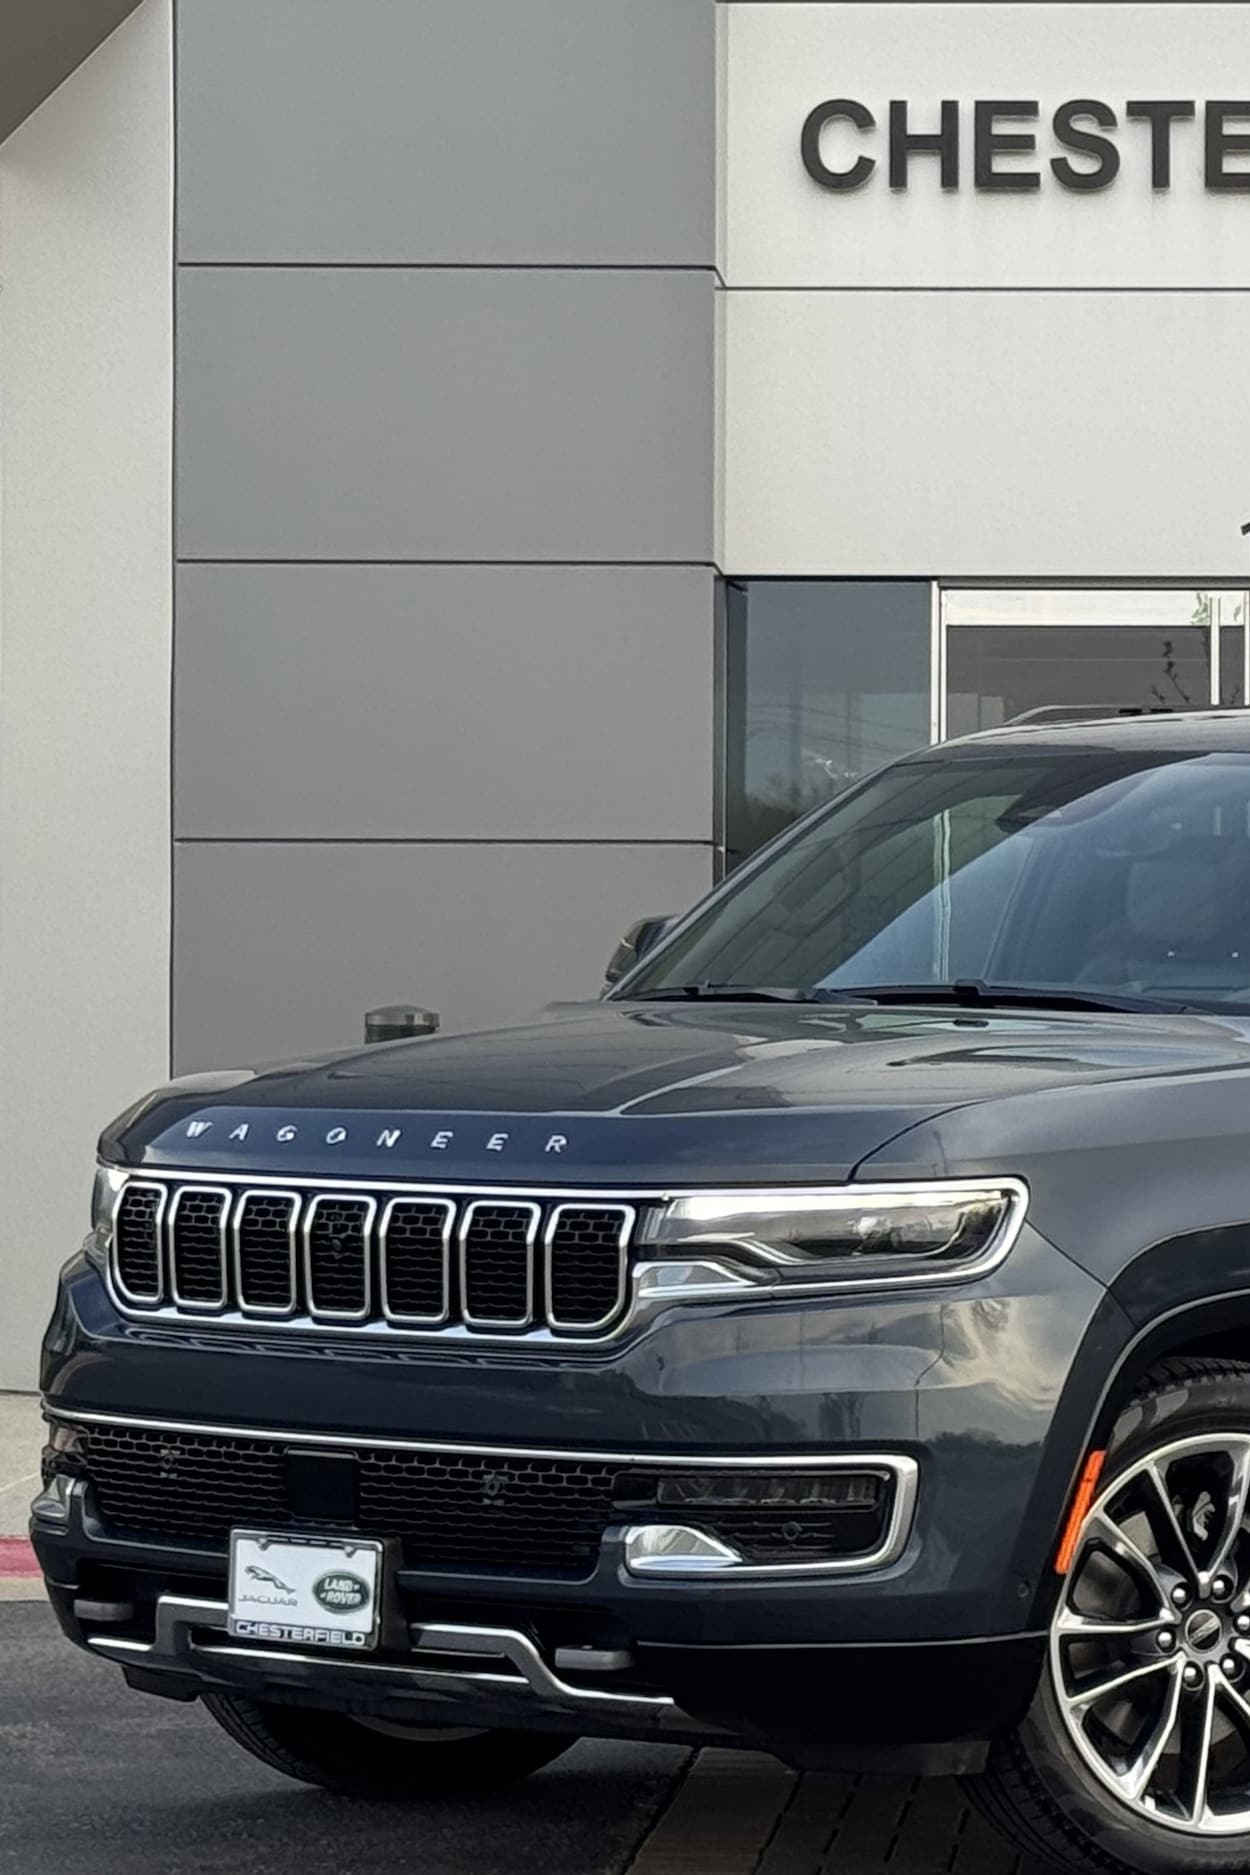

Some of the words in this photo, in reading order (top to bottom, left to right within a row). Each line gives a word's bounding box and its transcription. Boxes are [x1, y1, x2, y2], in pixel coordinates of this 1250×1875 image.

[186, 1120, 567, 1153] WAGONEER
[324, 1578, 354, 1593] LAND
[239, 1594, 298, 1608] JAGUAR
[325, 1591, 362, 1606] ROVER
[236, 1621, 366, 1646] CHESTERFIELD
